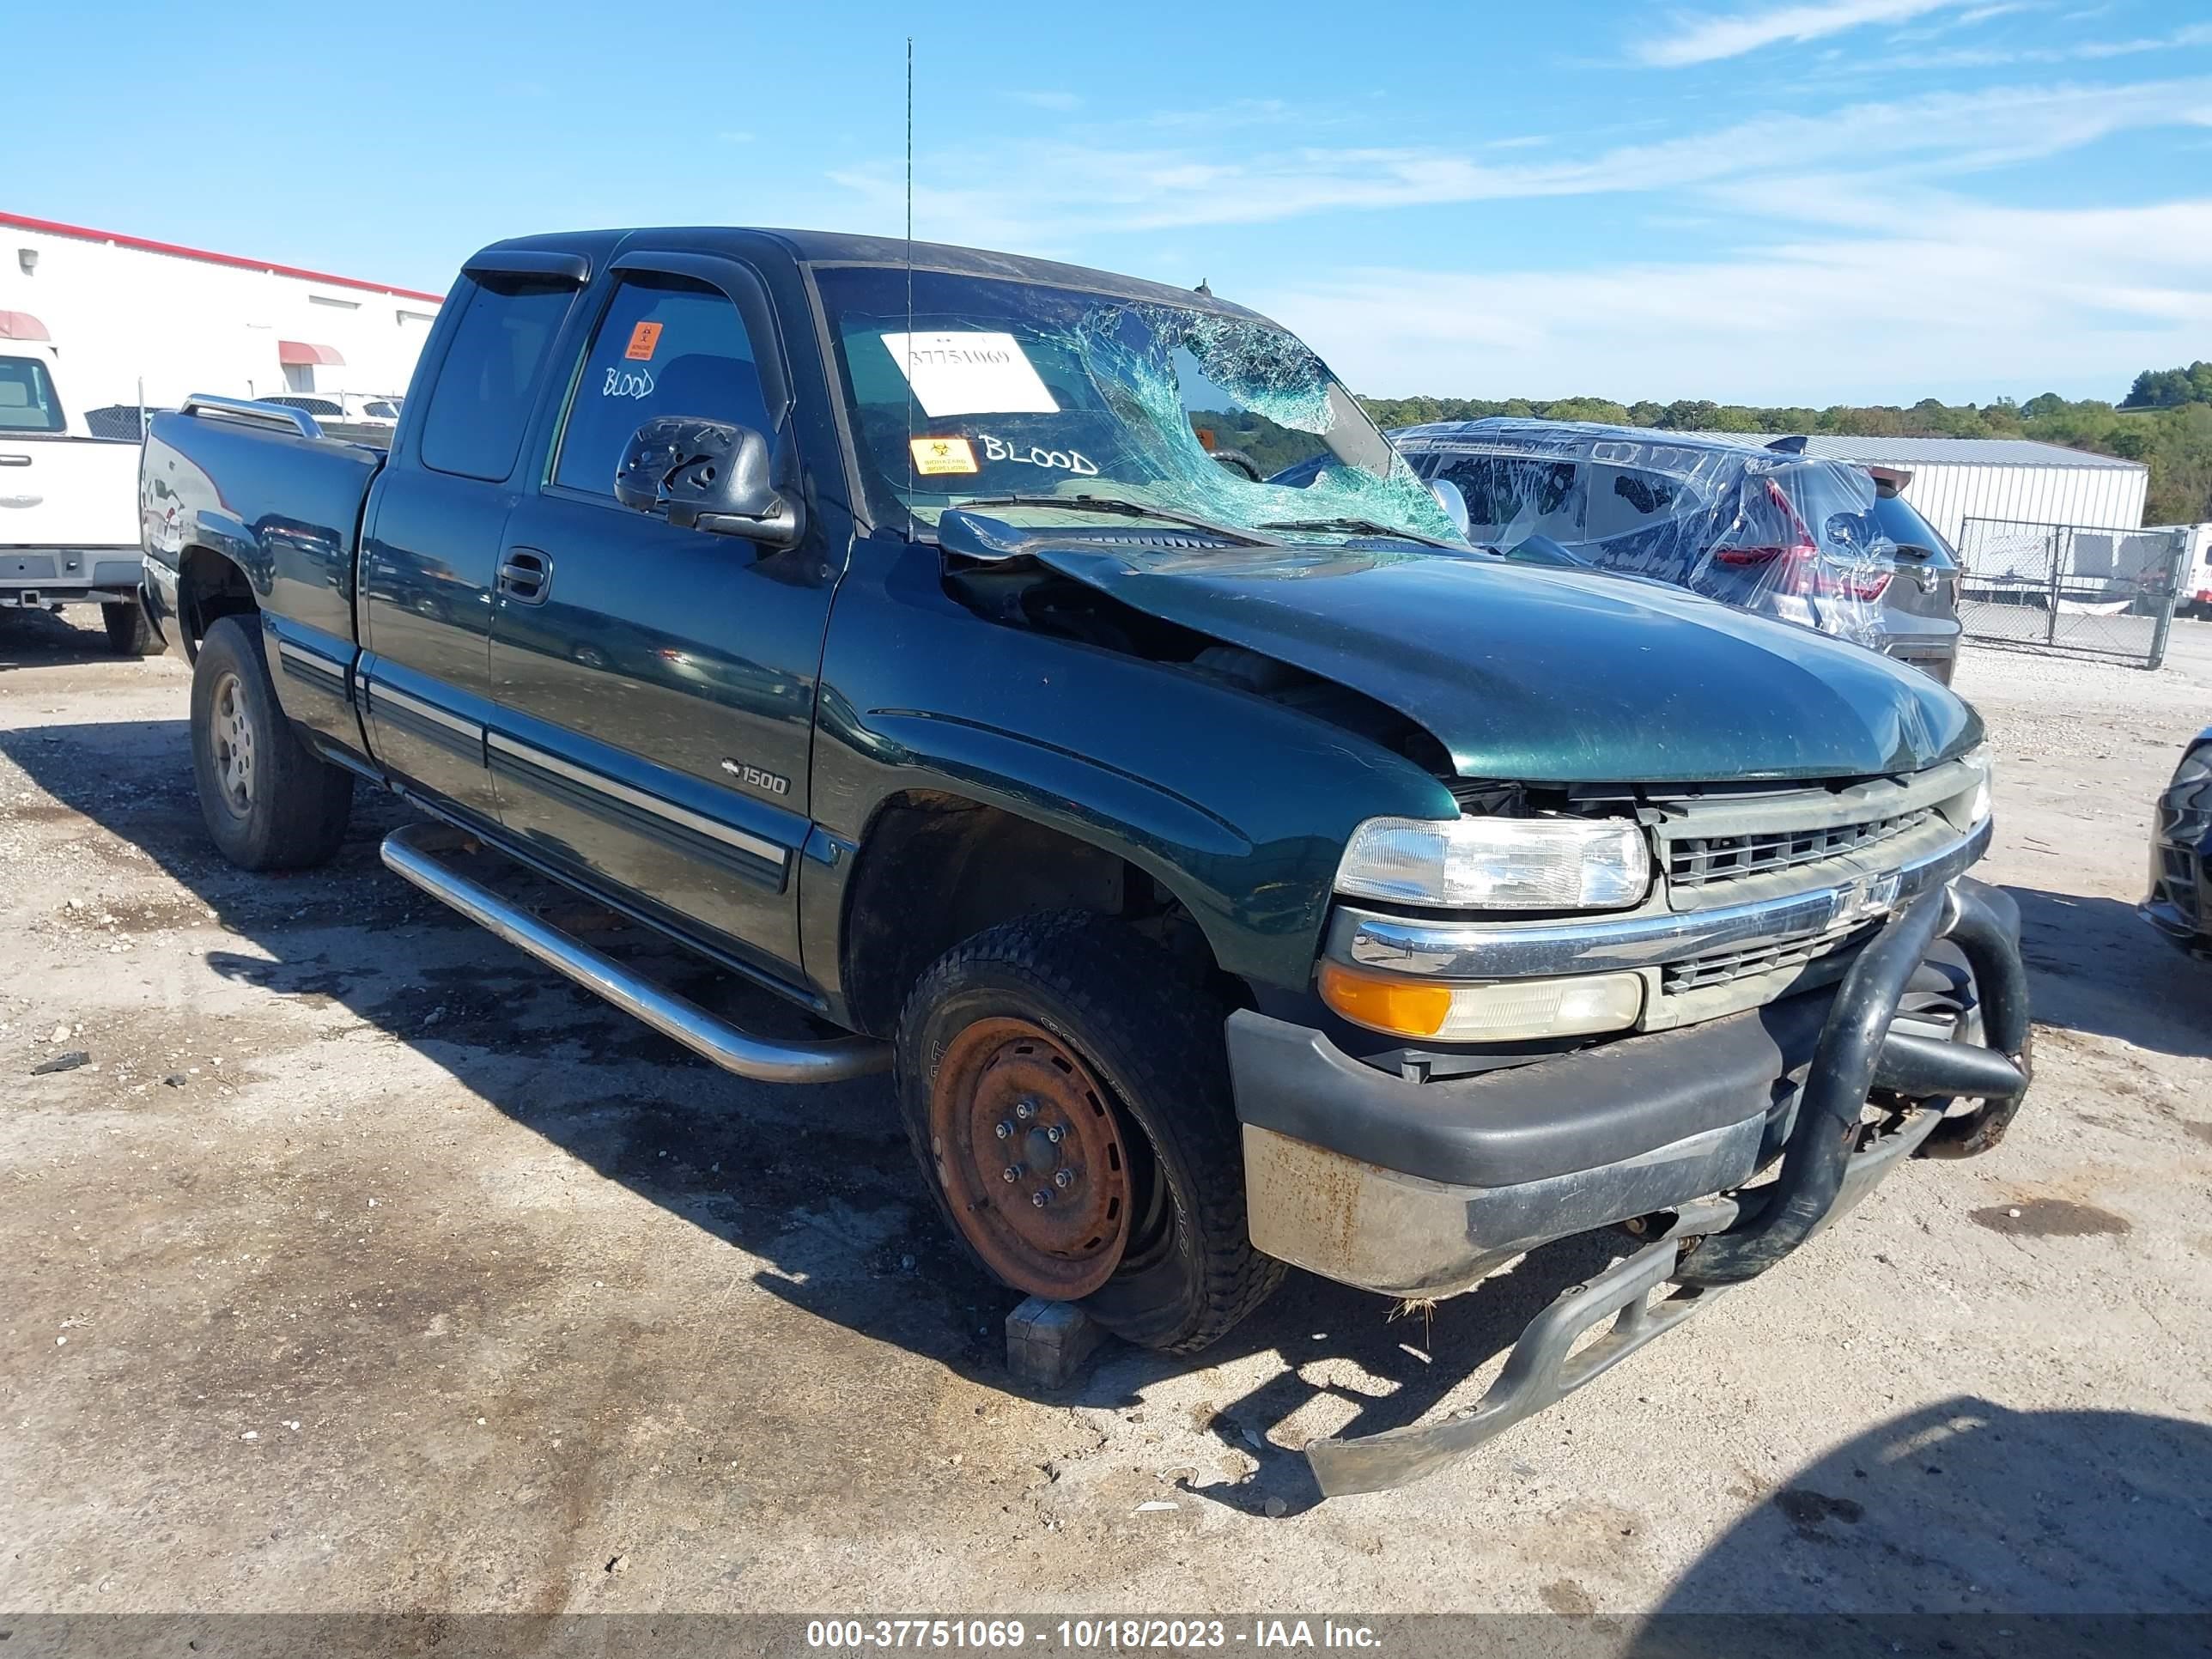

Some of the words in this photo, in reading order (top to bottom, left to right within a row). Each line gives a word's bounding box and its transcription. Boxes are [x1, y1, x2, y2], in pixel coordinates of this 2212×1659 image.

[909, 350, 1010, 366] 37751069
[603, 367, 655, 400] BLOOD
[978, 434, 1099, 476] BLOOD
[743, 767, 787, 794] 1500
